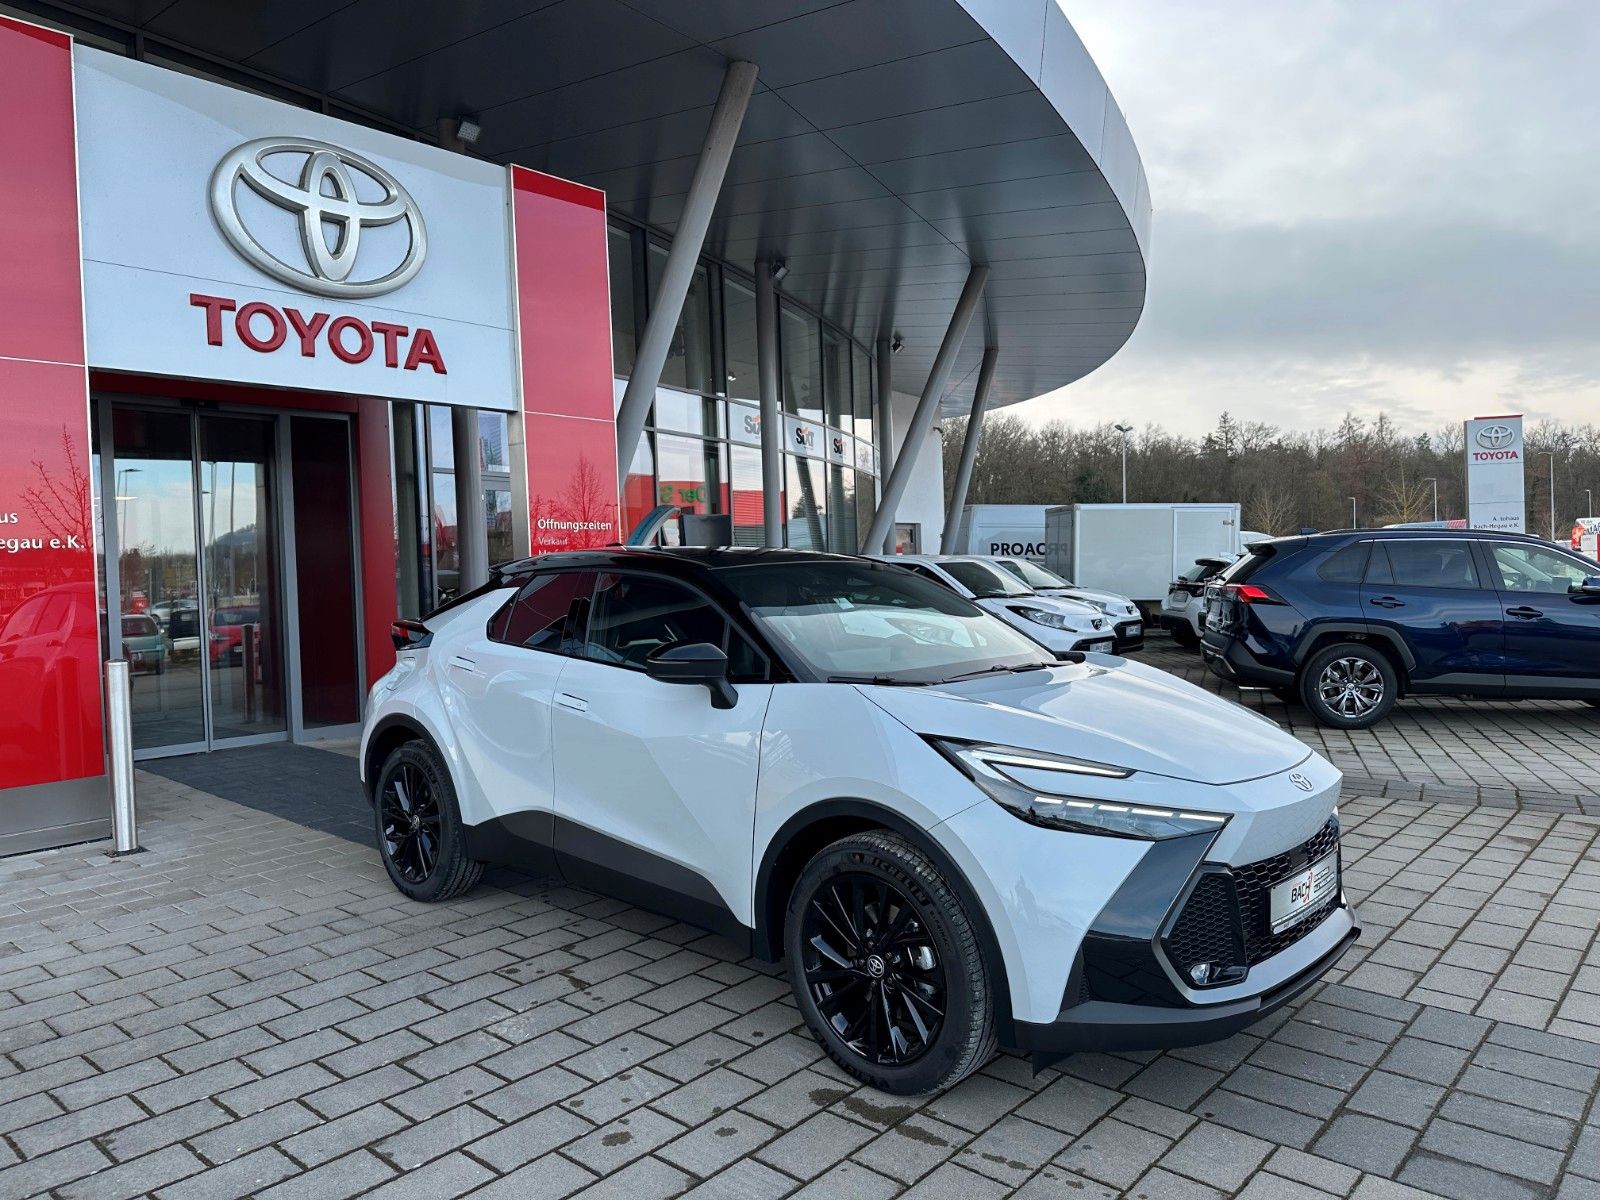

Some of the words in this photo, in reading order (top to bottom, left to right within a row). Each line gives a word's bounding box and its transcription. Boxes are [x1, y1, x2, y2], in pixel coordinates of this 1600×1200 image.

[190, 293, 447, 375] TOYOTA
[1473, 451, 1518, 461] TOYOTA
[537, 517, 612, 532] Öffnungszeiten
[50, 535, 85, 548] e.K.
[538, 537, 568, 545] Verkauf
[990, 542, 1046, 556] PROAC
